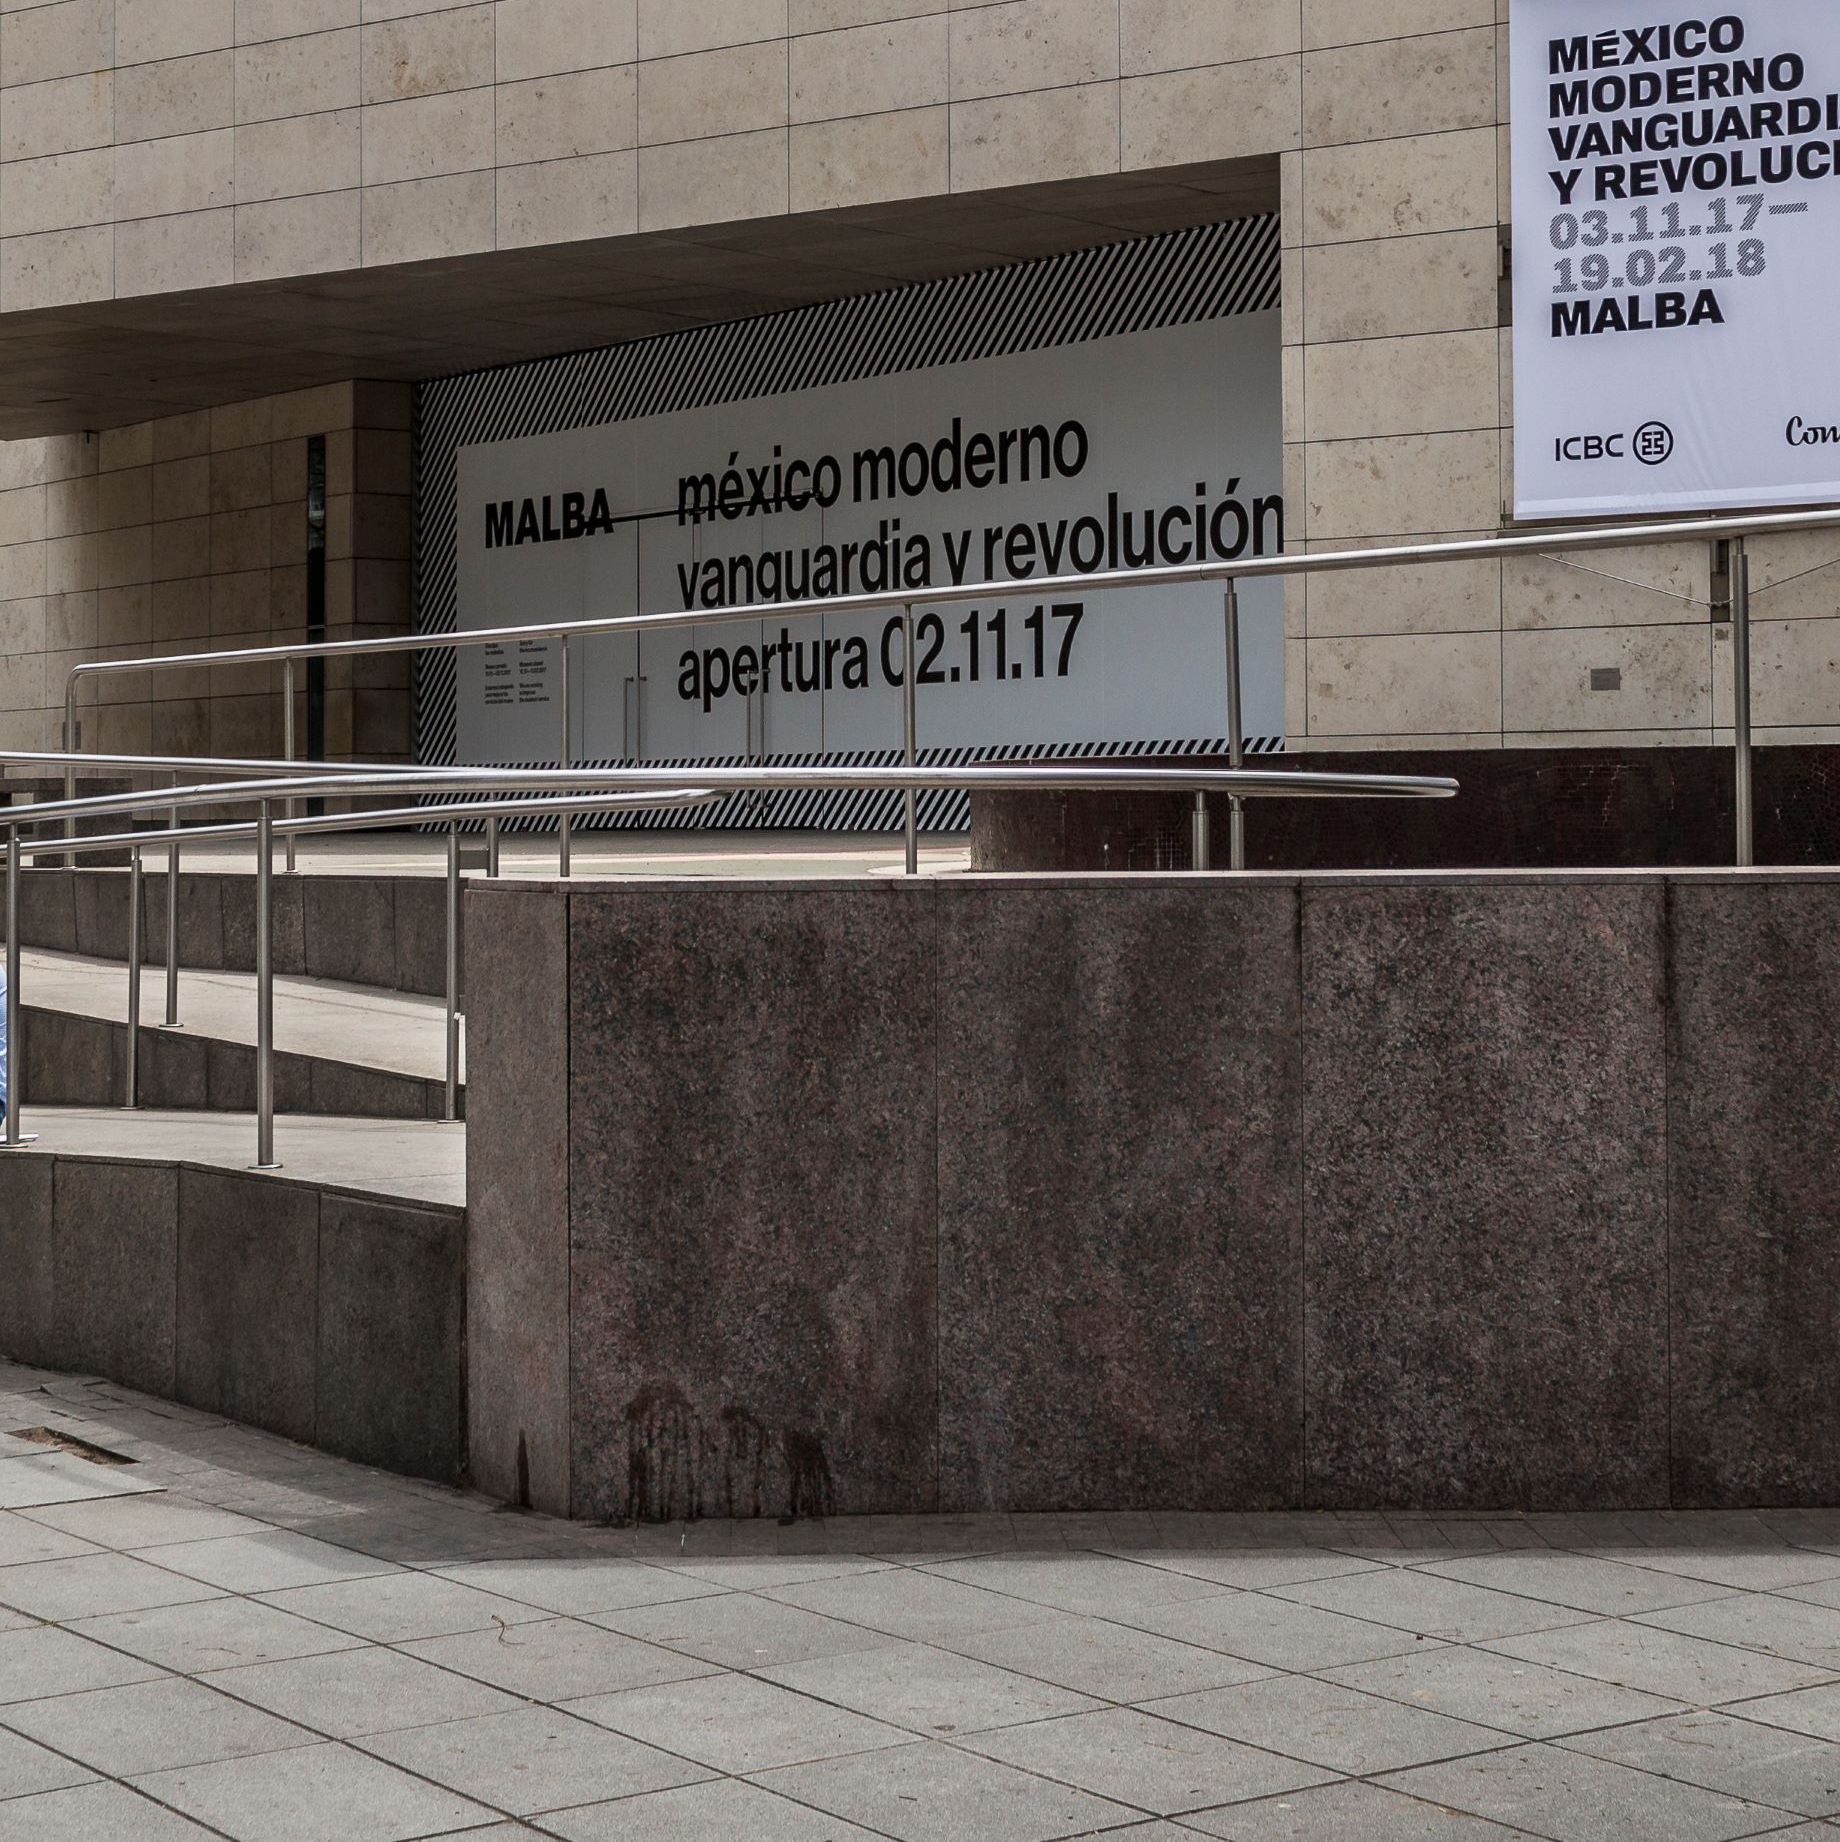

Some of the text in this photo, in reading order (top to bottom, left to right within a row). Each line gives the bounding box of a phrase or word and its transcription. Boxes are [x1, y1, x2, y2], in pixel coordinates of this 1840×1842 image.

[1549, 15, 1745, 74] MÉXICO
[1549, 53, 1804, 118] MODERNO
[1549, 167, 1582, 205] Y
[1552, 238, 1766, 293] 19.02.18
[1551, 288, 1725, 337] MALBA
[678, 417, 1088, 526] méxico moderno
[1556, 433, 1624, 462] ICBC
[485, 487, 614, 548] MALBA
[984, 477, 1284, 581] revolución
[677, 602, 1084, 713] apertura 02.11.17
